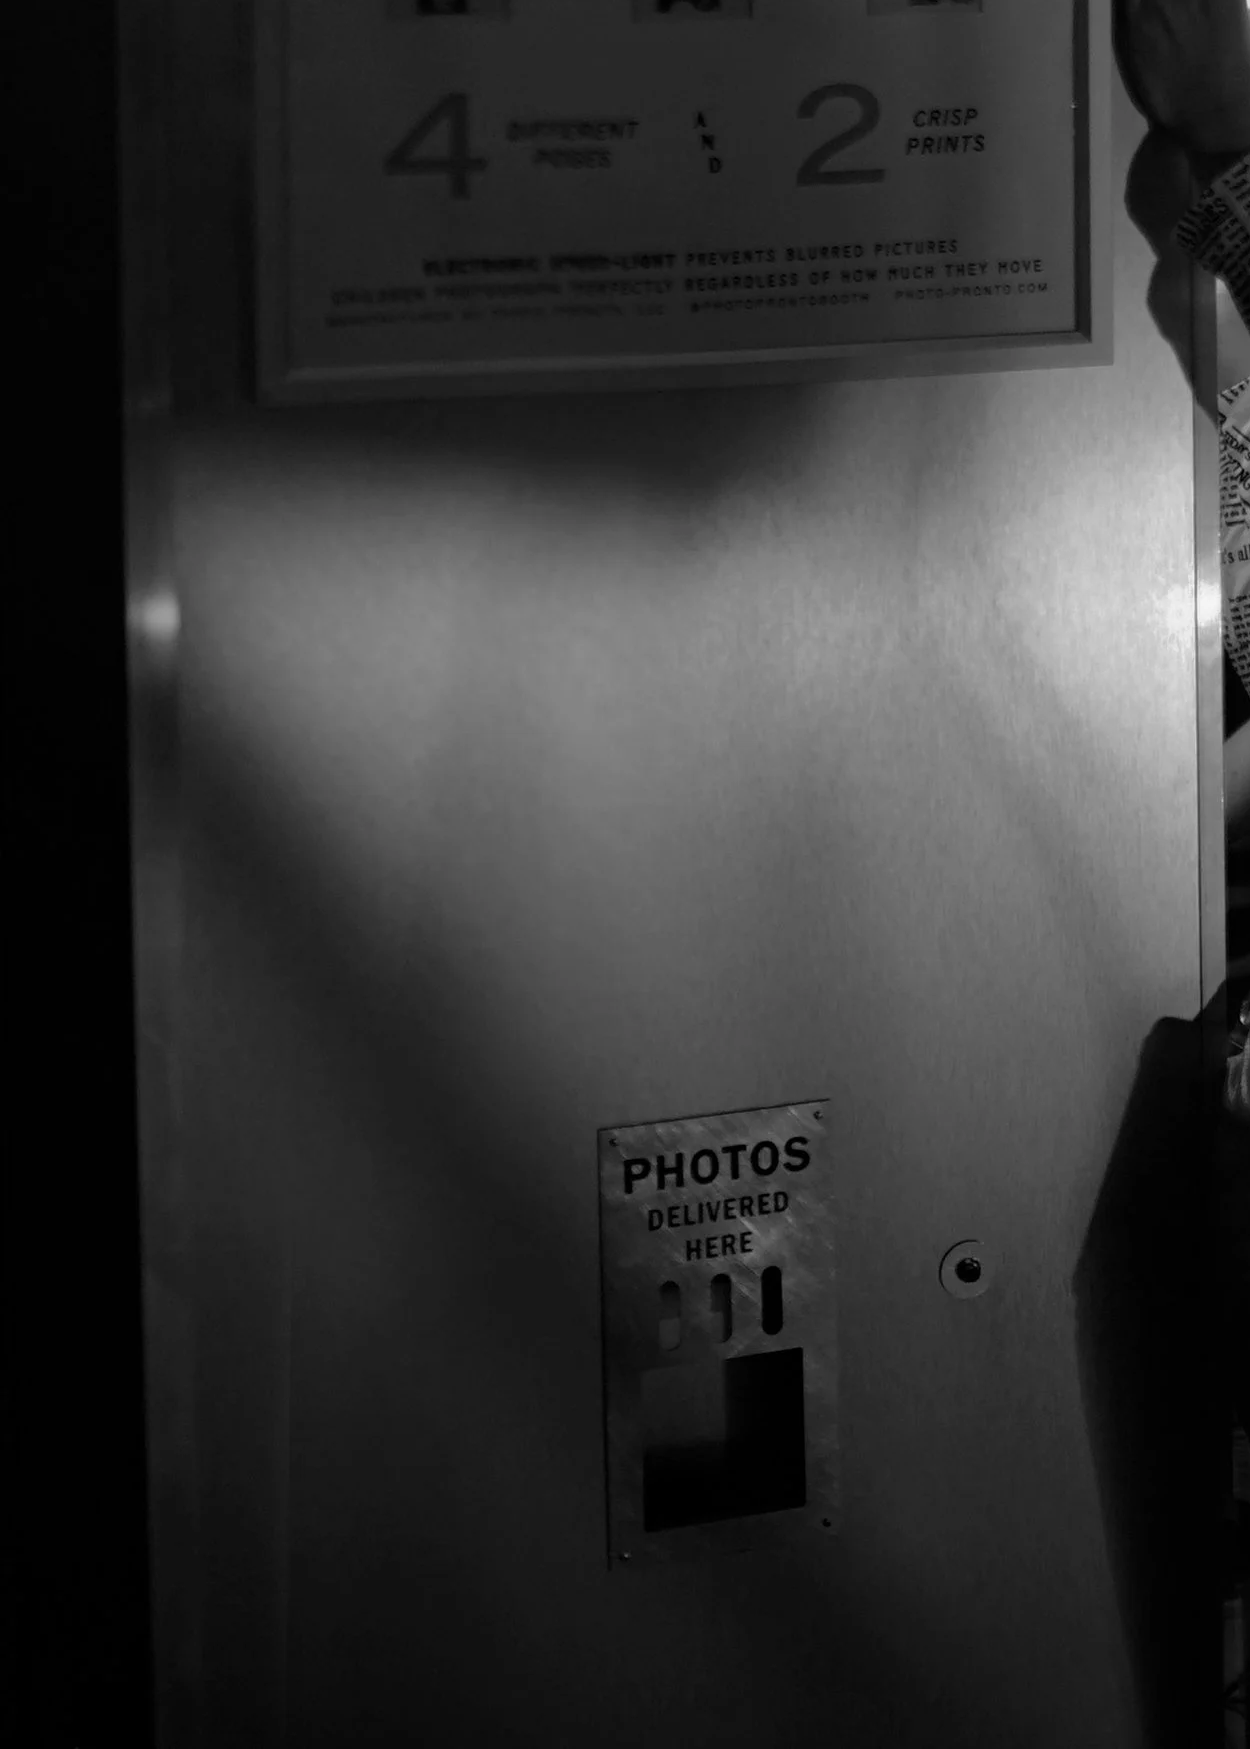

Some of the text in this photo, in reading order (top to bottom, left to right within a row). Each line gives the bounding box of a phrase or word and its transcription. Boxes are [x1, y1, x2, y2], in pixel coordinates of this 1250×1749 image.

[912, 108, 979, 127] CRISP
[382, 92, 489, 200] 4
[796, 83, 886, 188] 2
[905, 134, 985, 155] PRINTS
[685, 249, 776, 268] PREVENTS
[786, 244, 865, 262] BLURRED
[874, 239, 958, 256] PICTURES
[685, 273, 799, 292] REGARDLESS
[808, 270, 832, 286] OF
[840, 268, 878, 284] HOW
[888, 264, 936, 281] MUCH
[945, 261, 988, 278] THEY
[998, 257, 1044, 274] MOVE
[622, 1136, 812, 1195] PHOTOS
[647, 1190, 790, 1232] DELIVERED
[685, 1231, 753, 1262] HERE
